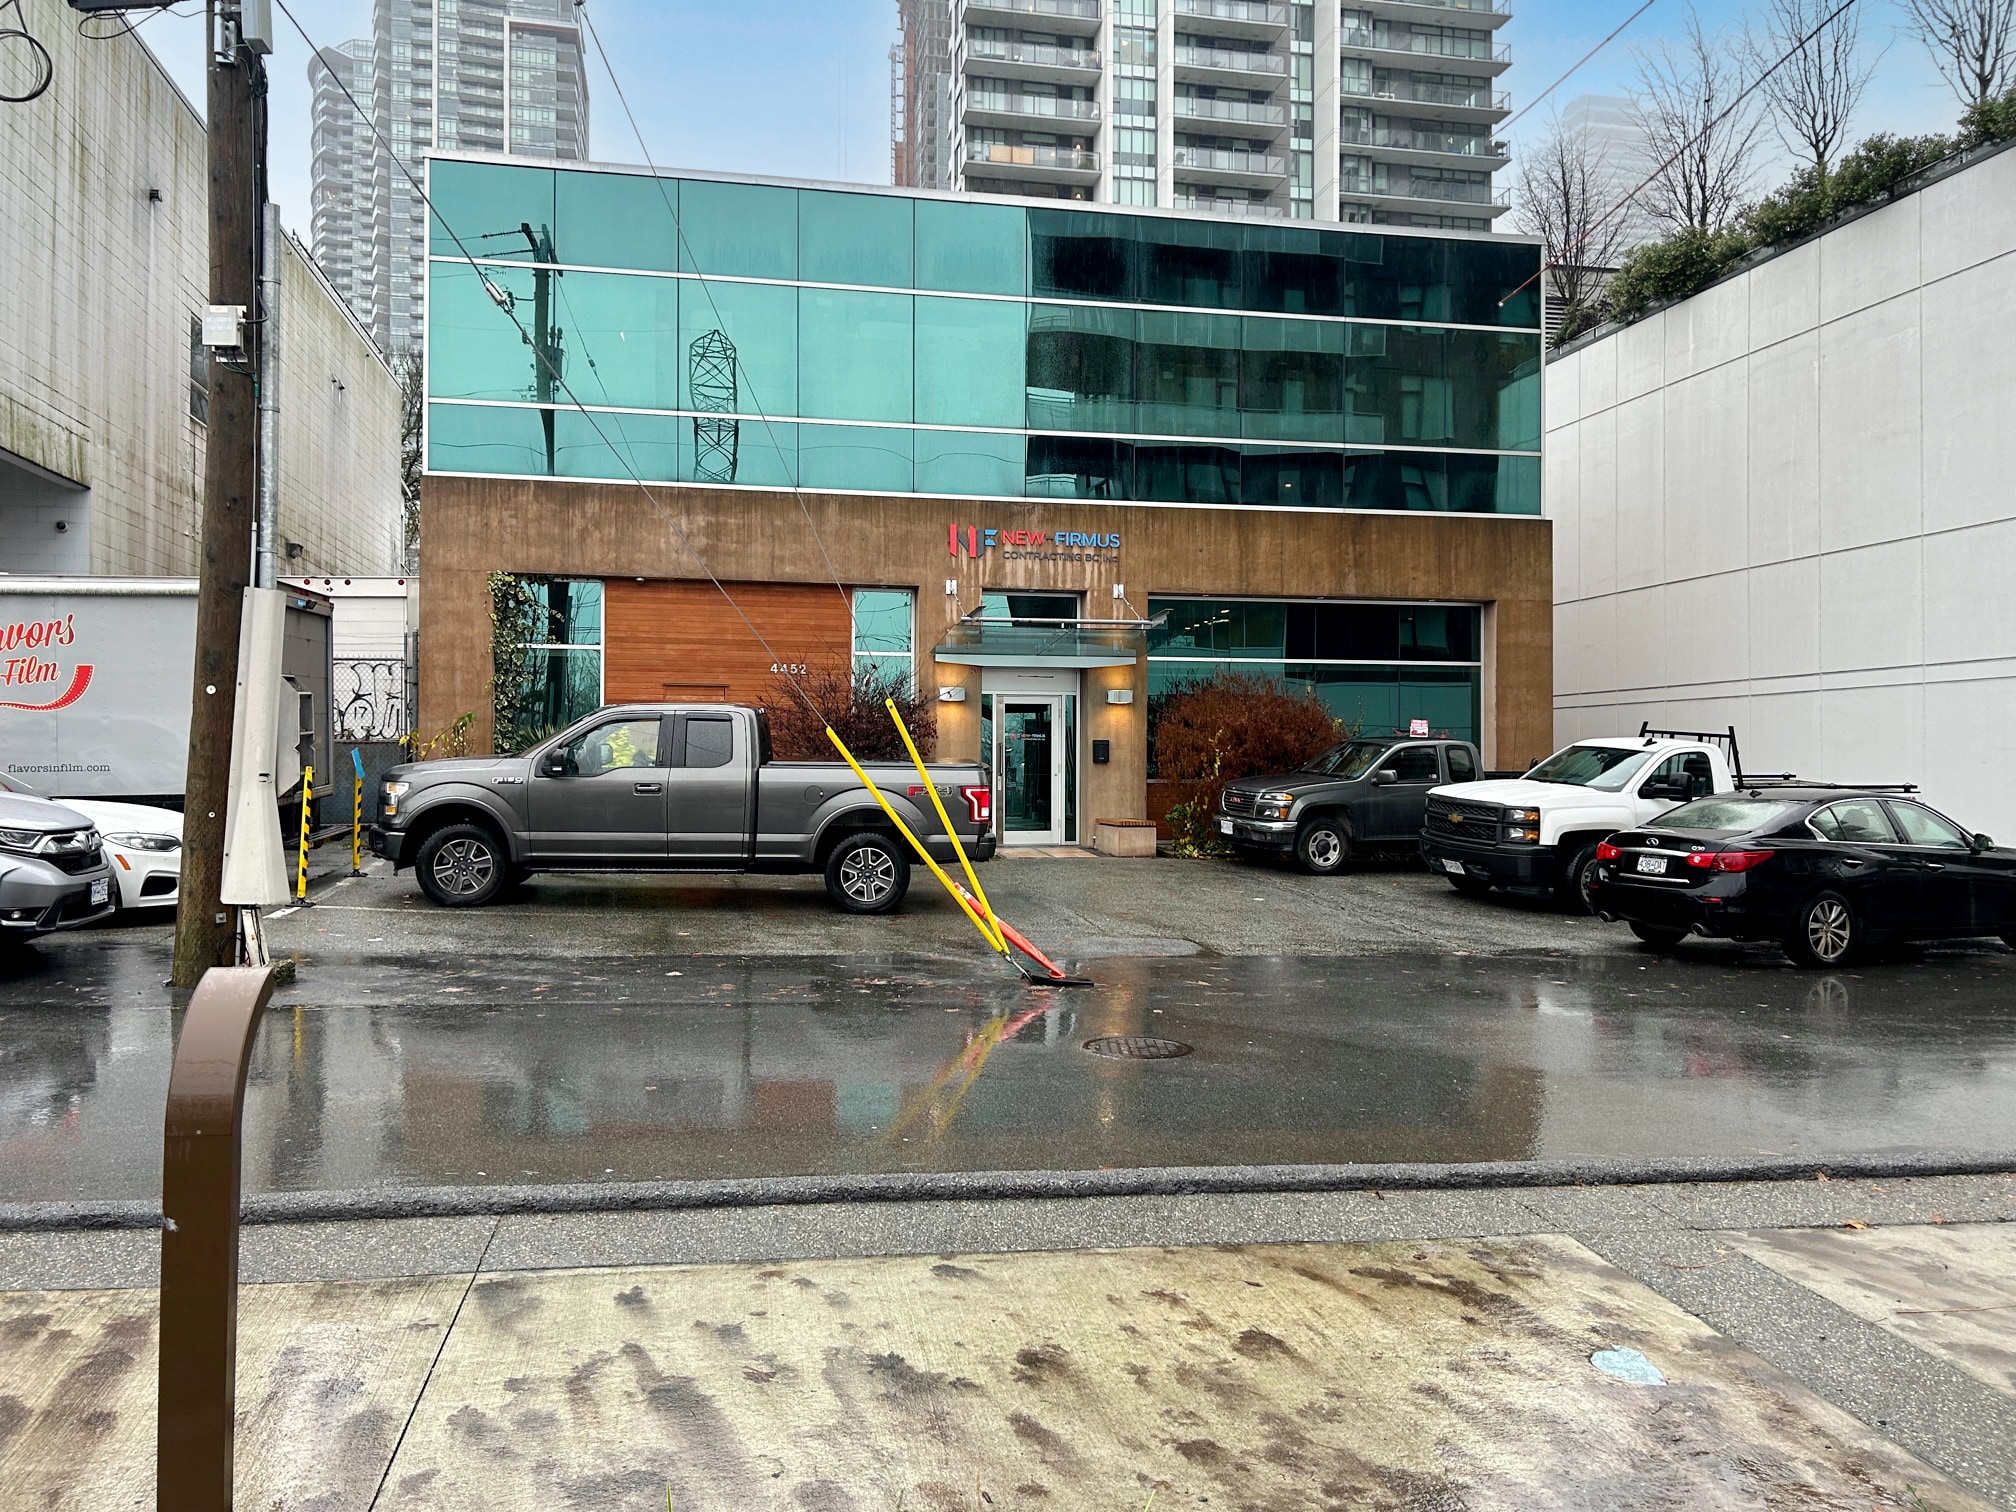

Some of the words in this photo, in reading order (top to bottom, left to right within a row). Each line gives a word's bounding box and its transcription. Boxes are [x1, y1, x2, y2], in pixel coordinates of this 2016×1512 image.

[1002, 551, 1082, 562] CONTRACTING
[1085, 553, 1100, 562] BC
[0, 655, 60, 686] Film
[770, 663, 807, 675] 4452
[8, 763, 110, 773] flavorsinfilm.com
